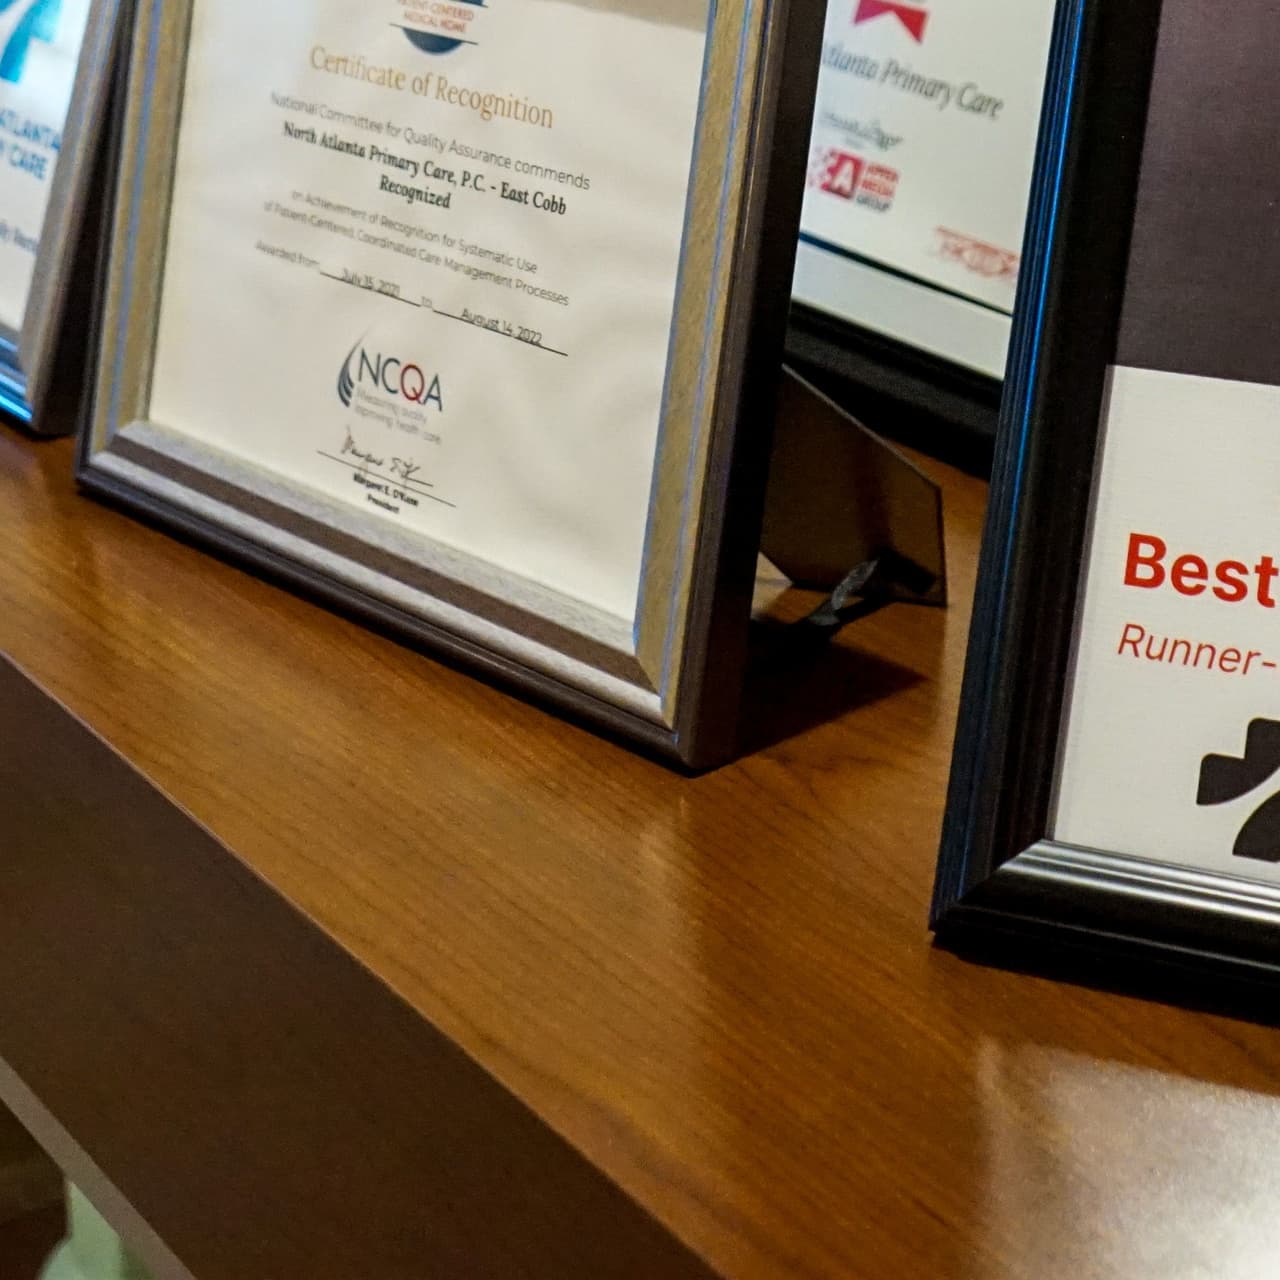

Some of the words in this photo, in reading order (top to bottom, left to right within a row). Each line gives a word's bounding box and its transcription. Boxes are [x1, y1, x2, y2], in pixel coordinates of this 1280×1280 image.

[310, 45, 406, 91] Certificate
[411, 72, 434, 97] of
[435, 76, 553, 129] Recognition
[880, 58, 953, 111] Primary
[957, 82, 1004, 120] Care
[9, 143, 48, 180] CARE
[270, 90, 318, 114] National
[319, 104, 383, 134] Committee
[385, 120, 402, 137] for
[404, 127, 447, 154] Quality
[449, 140, 512, 169] Assurance
[514, 159, 591, 191] commends
[284, 120, 317, 144] North
[320, 132, 366, 158] Atlanta
[369, 145, 420, 178] Primary
[423, 161, 457, 185] Care,
[461, 171, 486, 193] P.C.
[500, 182, 529, 206] East
[533, 191, 567, 216] Cobb
[379, 174, 451, 210] Recognized
[381, 214, 440, 243] Recognition
[442, 234, 456, 248] for
[459, 239, 514, 268] Systematic
[517, 258, 538, 274] Use
[419, 248, 442, 266] Care
[444, 256, 512, 288] Management
[515, 279, 569, 306] Processes
[461, 308, 500, 330] August
[517, 326, 543, 345] 2022
[358, 347, 443, 412] NCQA
[1123, 532, 1279, 609] Best
